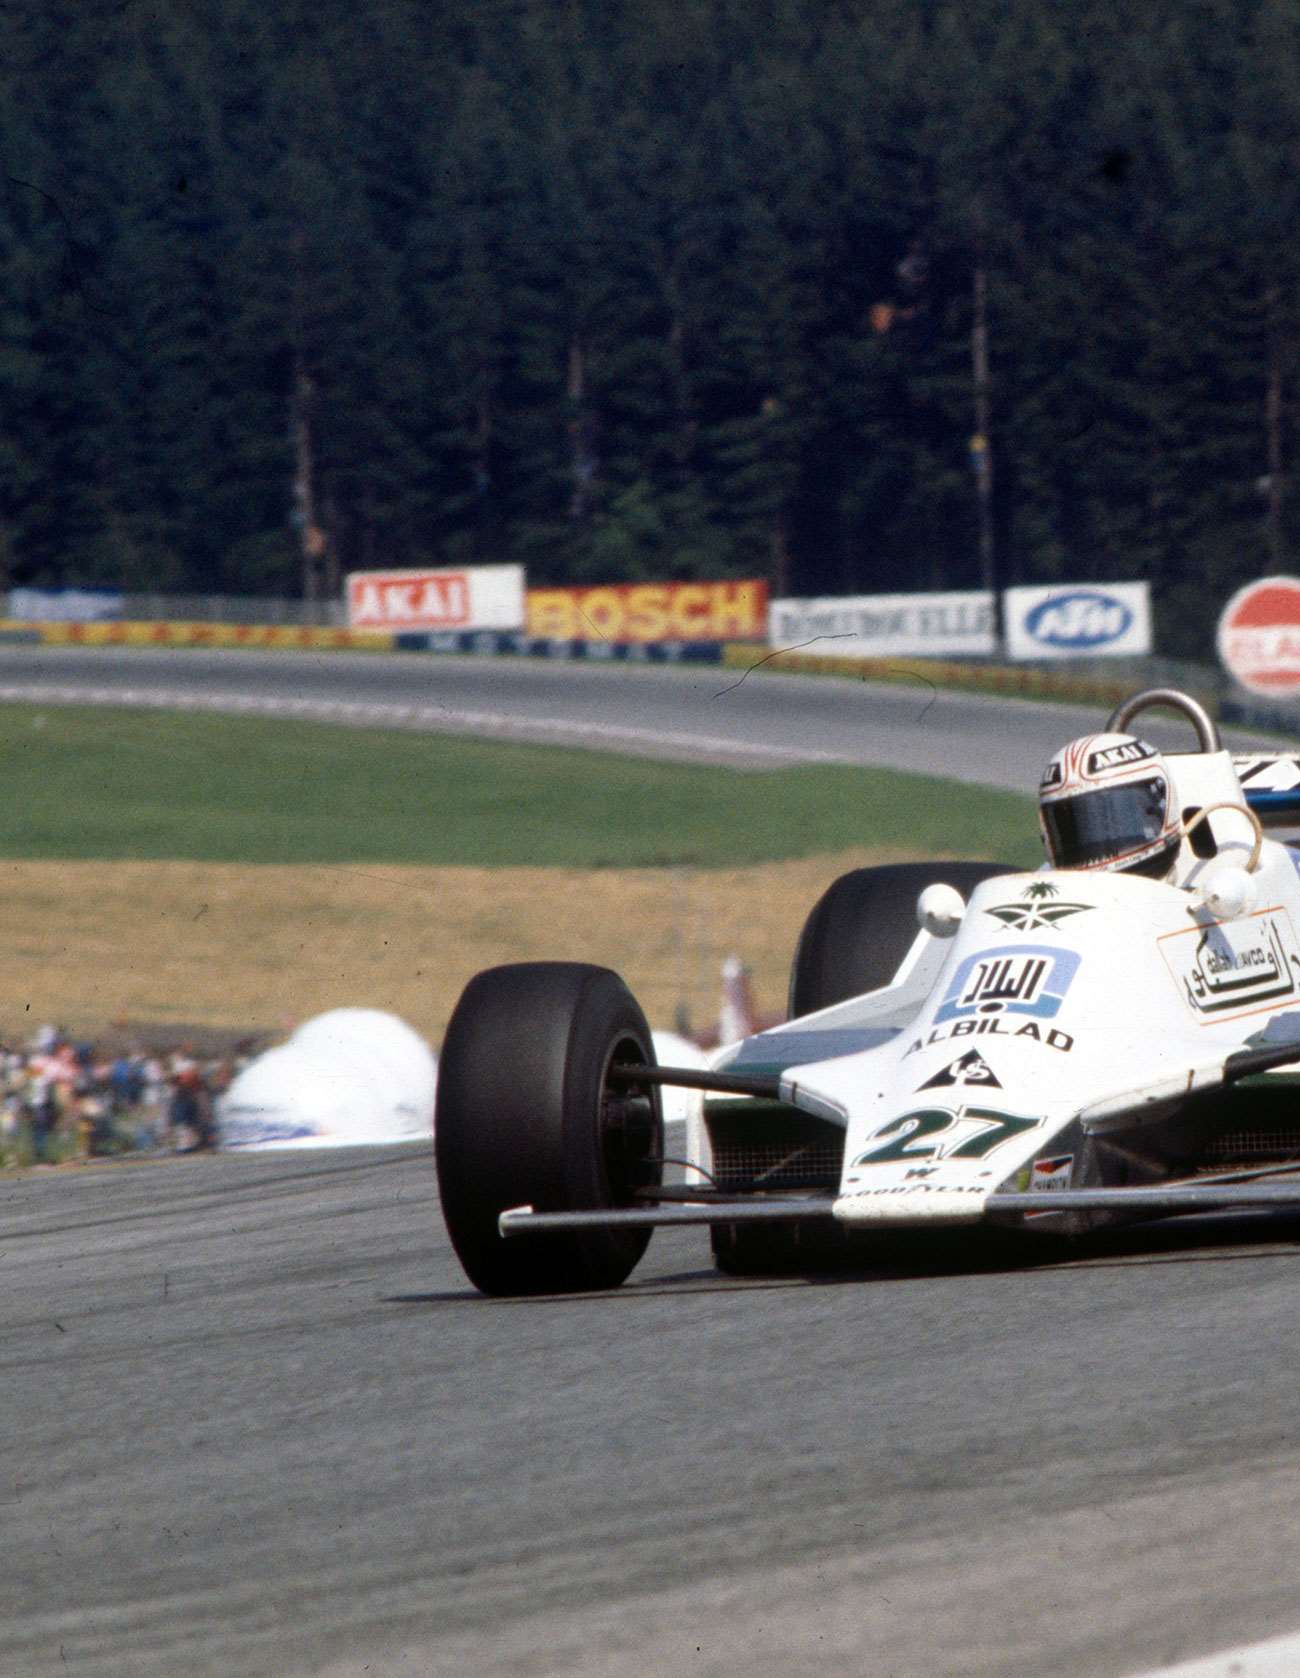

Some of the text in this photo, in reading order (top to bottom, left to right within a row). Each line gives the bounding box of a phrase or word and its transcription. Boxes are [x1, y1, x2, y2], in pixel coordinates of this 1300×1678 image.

[363, 583, 464, 619] AKAI
[528, 584, 757, 640] BOSCH
[1095, 745, 1142, 768] AKAI
[902, 1018, 1074, 1060] ALBILAD
[852, 1105, 1046, 1167] 27
